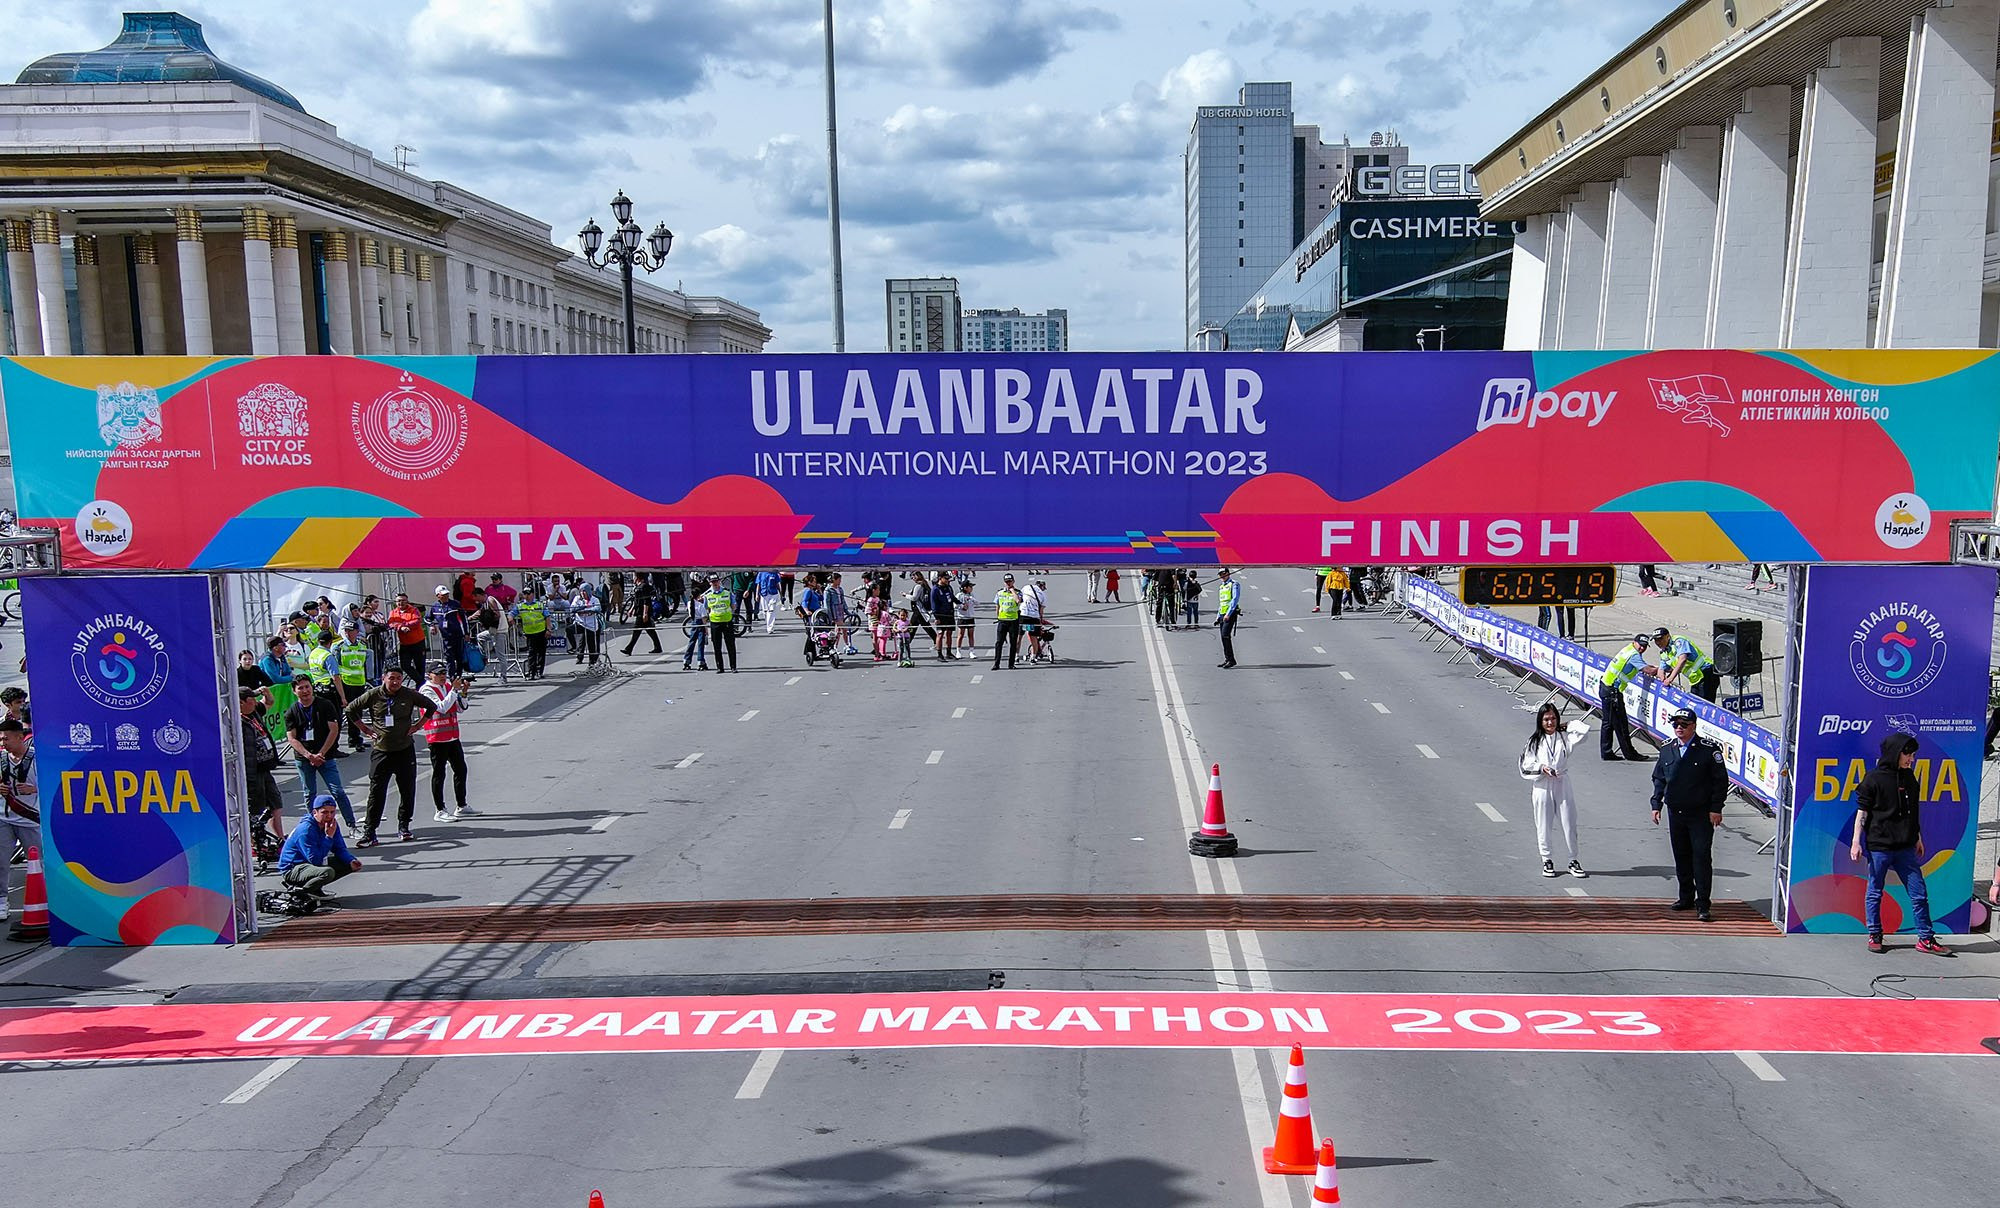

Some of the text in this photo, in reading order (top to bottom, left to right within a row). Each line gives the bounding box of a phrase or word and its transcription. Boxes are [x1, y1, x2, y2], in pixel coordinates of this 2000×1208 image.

[1201, 108, 1287, 118] UB GRAND HOTEL
[1350, 217, 1498, 239] CASHMERE
[750, 368, 1267, 437] ULAANBAATAR
[1741, 388, 1880, 402] МОНГОЛЫН ХӨНГӨН
[1740, 404, 1890, 420] АТЛЕТИКИЙН ХОЛБОО
[65, 449, 201, 459] НИЙСЛЭЛИЙН ЗАСАГ ДАРГЫН
[245, 439, 306, 452] CITY OF
[98, 460, 170, 469] ТАМГЫН ГАЗАР
[241, 453, 313, 466] NOMADS
[754, 450, 1268, 477] INTERNATIONAL MARATHON 2023
[85, 528, 127, 544] Нэгдье!
[1321, 519, 1579, 557] FINISH
[1883, 521, 1924, 537] Нэгдье!
[447, 523, 683, 561] START
[73, 613, 165, 653] УЛААНБААТАР
[1853, 602, 1945, 642] УЛААНБААТАР
[1856, 662, 1876, 687] ОЛОН
[1877, 684, 1911, 695] УЛСЫН
[80, 674, 102, 698] ОЛОН
[104, 695, 140, 706] УЛСЫН
[1725, 697, 1762, 710] POICE
[61, 770, 201, 814] ГАРАА
[235, 1006, 1662, 1042] ULAANBAATAR MARATHON 2023
